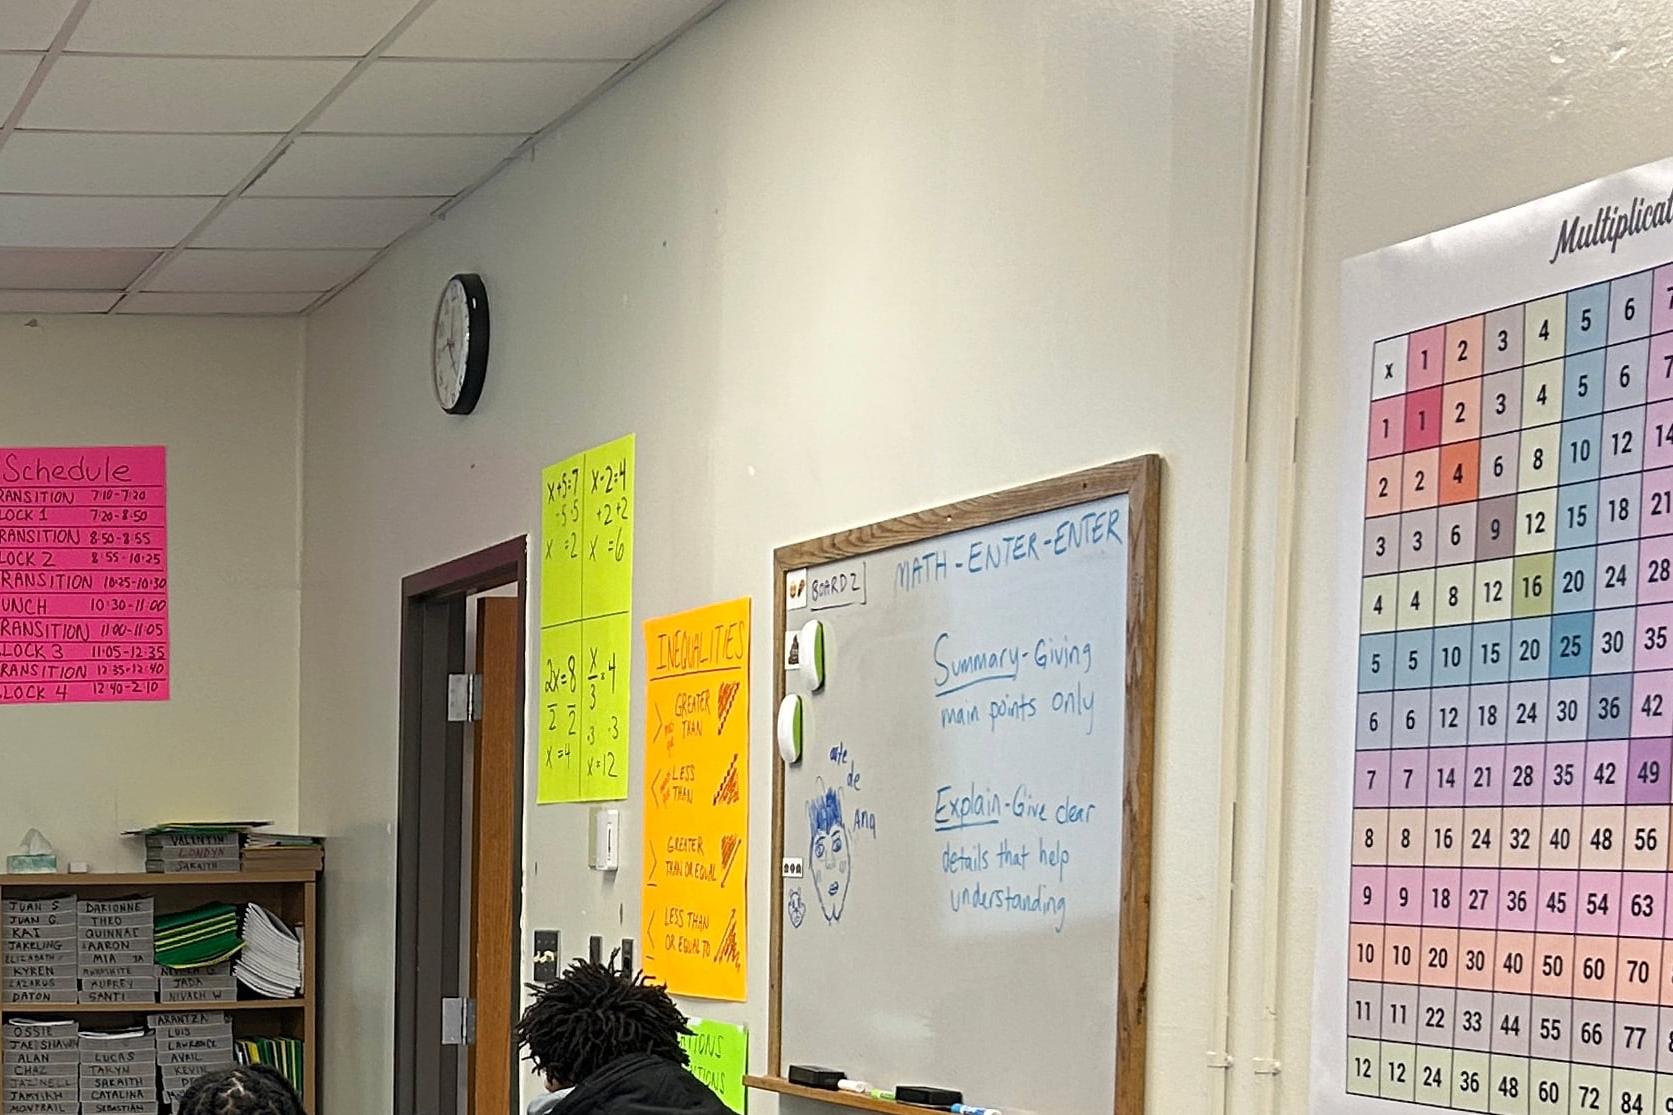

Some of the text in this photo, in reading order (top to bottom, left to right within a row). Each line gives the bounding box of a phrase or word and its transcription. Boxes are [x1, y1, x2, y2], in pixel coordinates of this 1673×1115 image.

[1538, 297, 1635, 342] 4 5 6
[1570, 431, 1632, 463] 10 12
[3, 453, 132, 482] Schedule
[39, 509, 47, 521] 1
[42, 552, 56, 567] 2
[1522, 559, 1671, 598] 16 20 24 28
[52, 643, 63, 659] 3
[656, 621, 745, 671] INEQUALITIES
[1560, 626, 1667, 658] 25 30 35
[56, 685, 67, 699] 4
[675, 689, 711, 717] GREATER
[941, 693, 1036, 731] main points
[1638, 761, 1660, 784] 49
[943, 837, 1069, 882] details that help
[951, 883, 1066, 933] understanding
[1586, 893, 1653, 917] 54 63
[93, 953, 116, 963] MIA
[1621, 1092, 1643, 1115] 84
